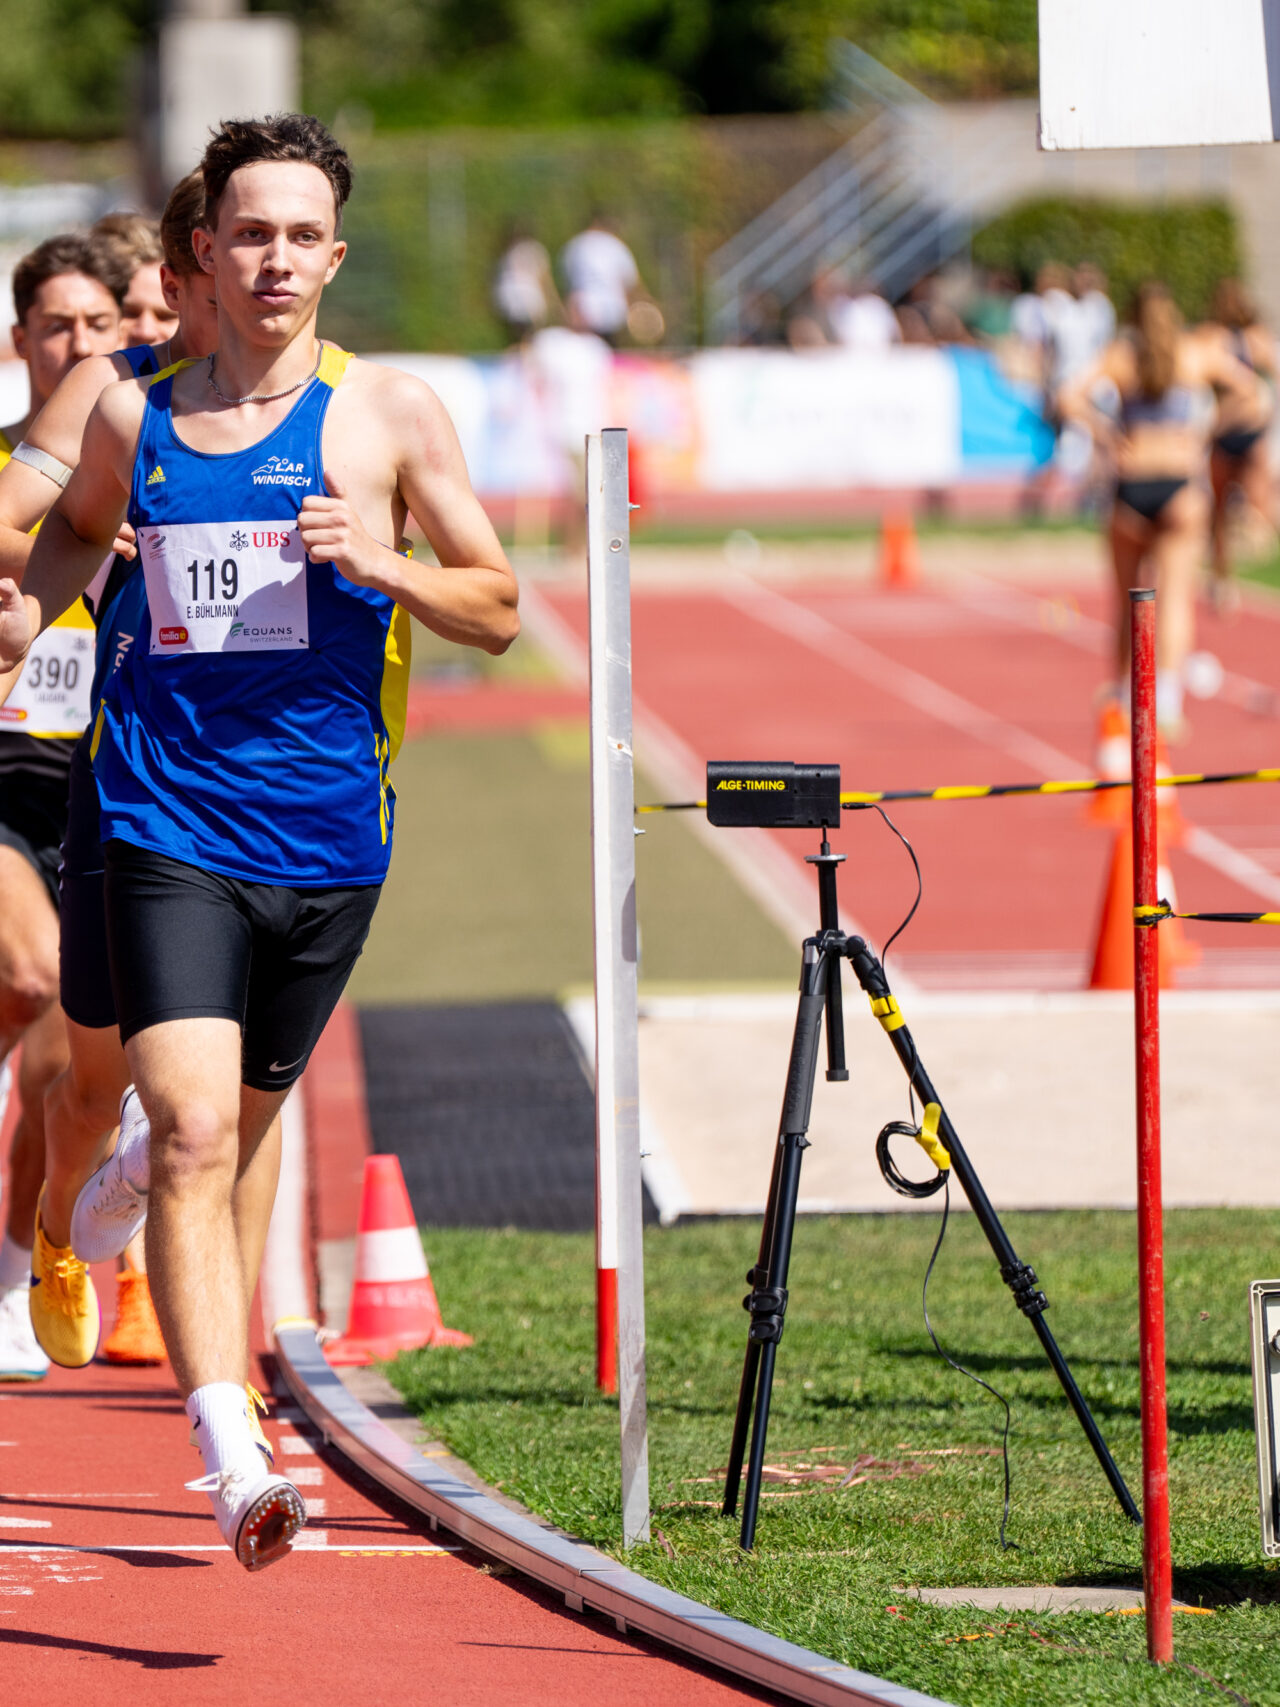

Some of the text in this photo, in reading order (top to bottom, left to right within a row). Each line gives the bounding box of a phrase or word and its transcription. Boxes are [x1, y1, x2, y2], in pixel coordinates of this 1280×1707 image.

[253, 475, 312, 487] WINDISCH
[252, 531, 290, 548] UBS
[187, 558, 238, 601] 119
[186, 603, 239, 619] E. BÜHLMANN
[243, 627, 293, 637] EQUANS
[28, 656, 80, 690] 390
